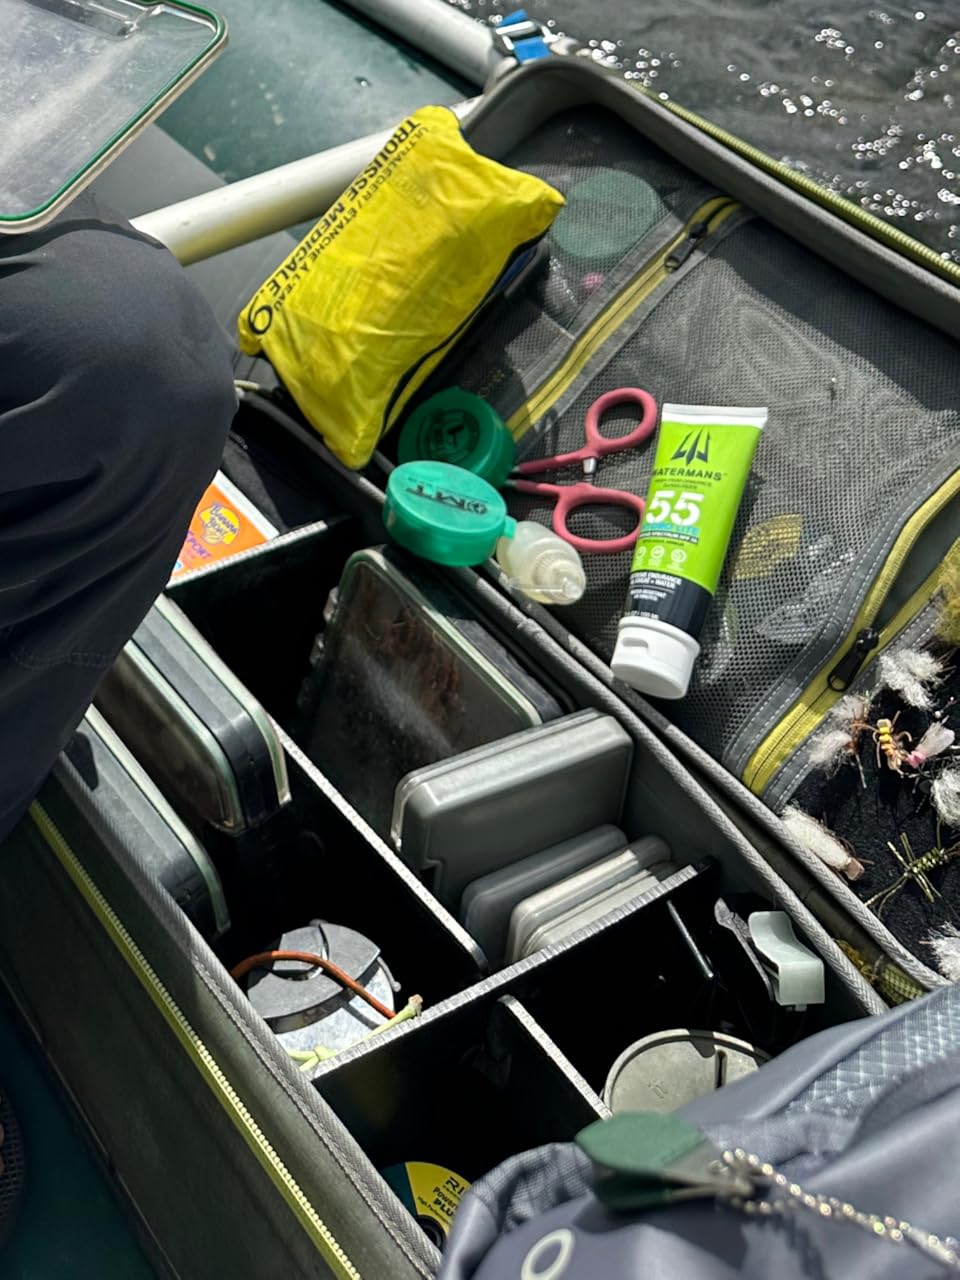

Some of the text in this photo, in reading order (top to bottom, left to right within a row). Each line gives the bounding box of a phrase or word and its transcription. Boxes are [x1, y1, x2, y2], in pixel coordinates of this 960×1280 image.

[346, 119, 421, 201] TROUSSE
[646, 490, 704, 526] 55
[433, 1186, 457, 1209] Power
[433, 1198, 454, 1217] PLU
